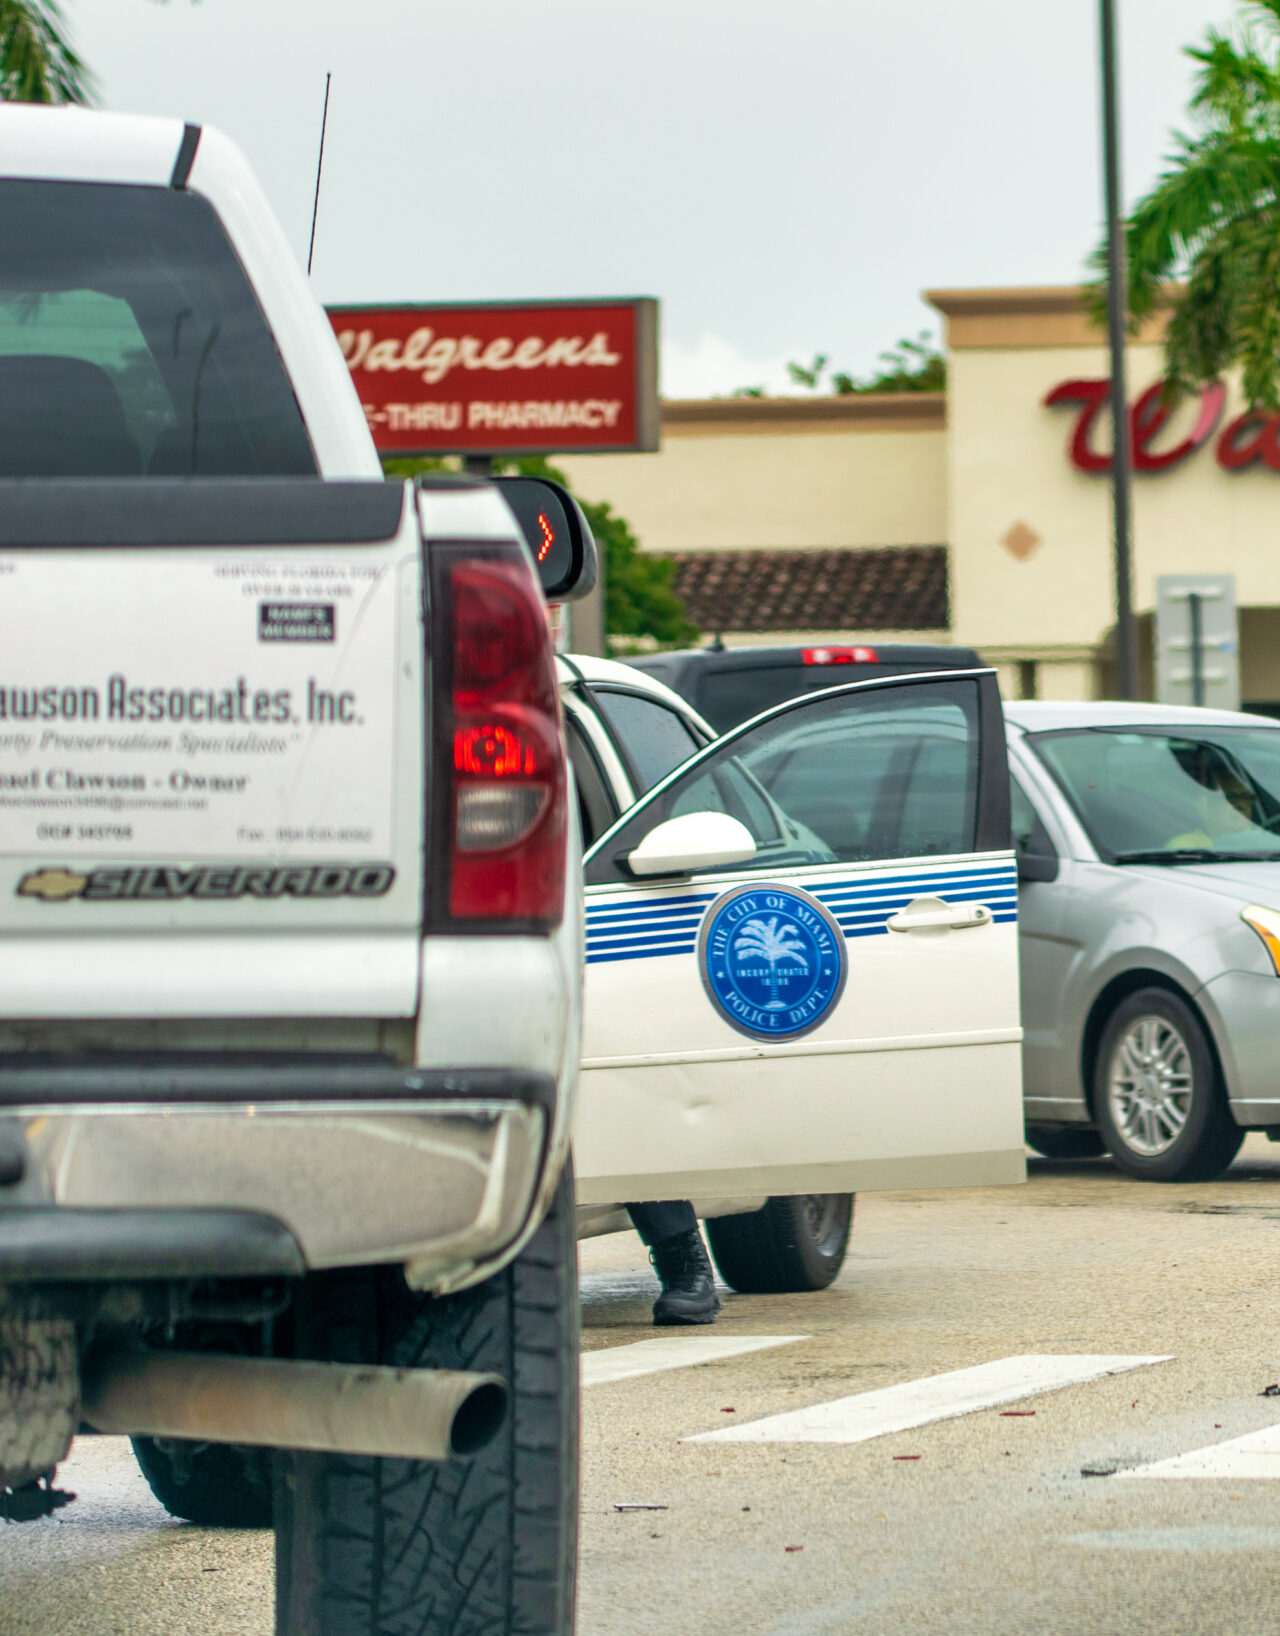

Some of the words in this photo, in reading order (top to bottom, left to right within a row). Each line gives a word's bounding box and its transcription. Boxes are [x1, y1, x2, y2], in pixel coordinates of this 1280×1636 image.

[468, 398, 621, 429] PHARMACY
[106, 672, 302, 726] Associates,
[307, 675, 365, 726] Inc.
[46, 769, 147, 791] Clawson
[168, 769, 249, 792] Owner
[82, 864, 394, 899] SILVERADO
[713, 925, 731, 956] THE
[726, 897, 759, 922] CITY
[766, 896, 788, 909] OF
[794, 906, 832, 955] MIAMI
[725, 991, 780, 1027] POLICE
